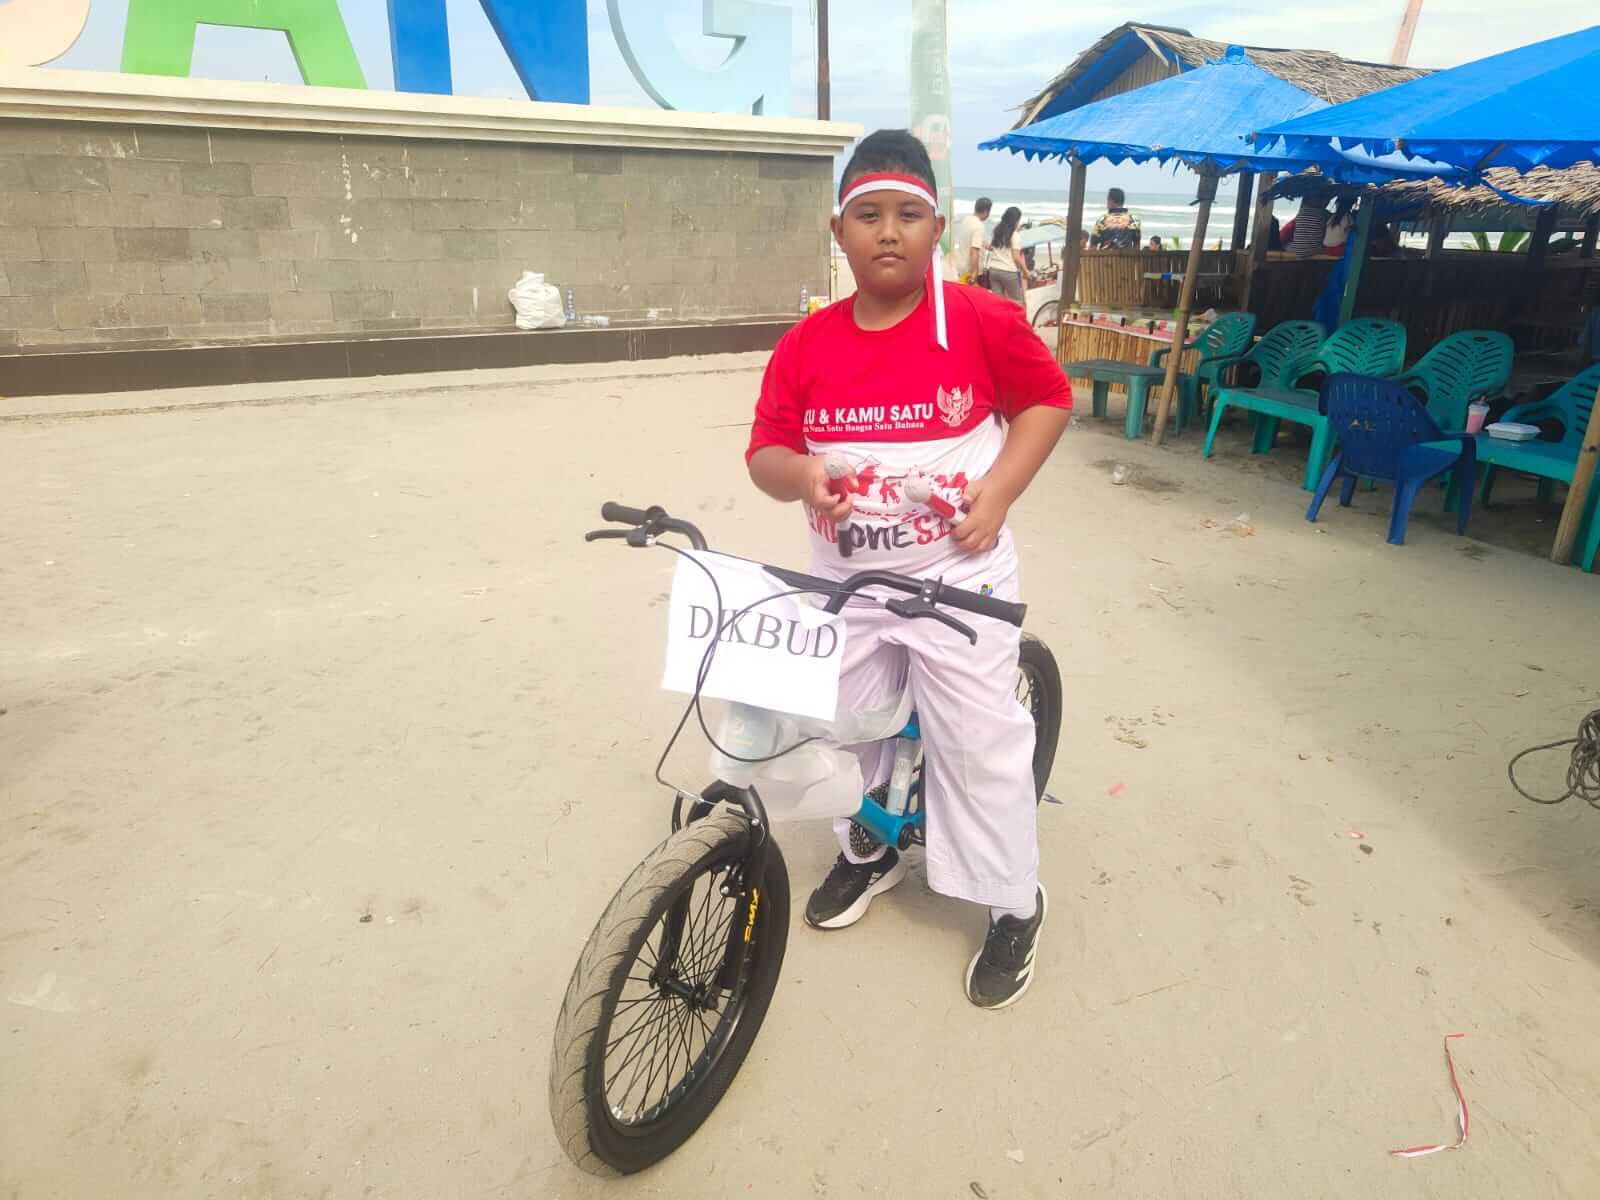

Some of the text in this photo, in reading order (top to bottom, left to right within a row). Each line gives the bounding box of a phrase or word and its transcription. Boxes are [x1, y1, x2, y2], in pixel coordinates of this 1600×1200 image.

[818, 408, 830, 425] &
[835, 406, 885, 424] KAMU
[890, 403, 934, 421] SATU
[687, 604, 839, 659] DIKBUD
